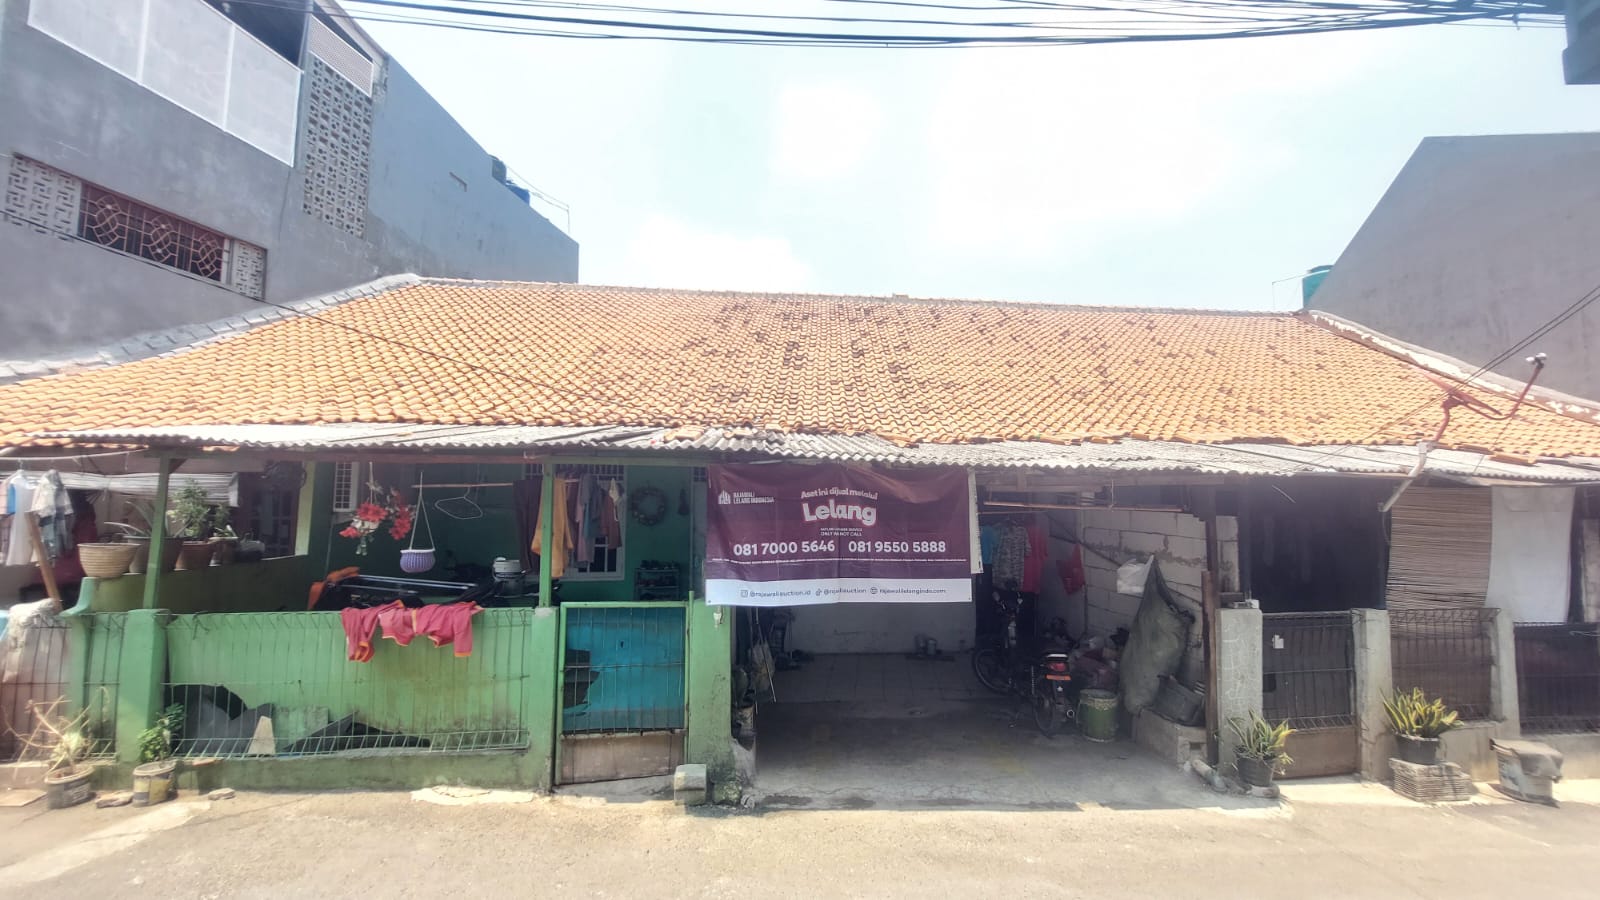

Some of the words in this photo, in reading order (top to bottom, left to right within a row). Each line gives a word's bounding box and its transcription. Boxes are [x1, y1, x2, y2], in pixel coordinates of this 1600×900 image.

[801, 490, 818, 499] Aset
[818, 488, 828, 496] ini
[829, 486, 848, 496] dijual
[849, 488, 878, 500] melalui
[802, 499, 876, 526] Lelang
[734, 544, 758, 556] 081
[761, 542, 798, 555] 7000
[801, 540, 835, 552] 5646
[848, 541, 871, 552] 081
[874, 541, 909, 552] 9550
[912, 541, 946, 552] 5888
